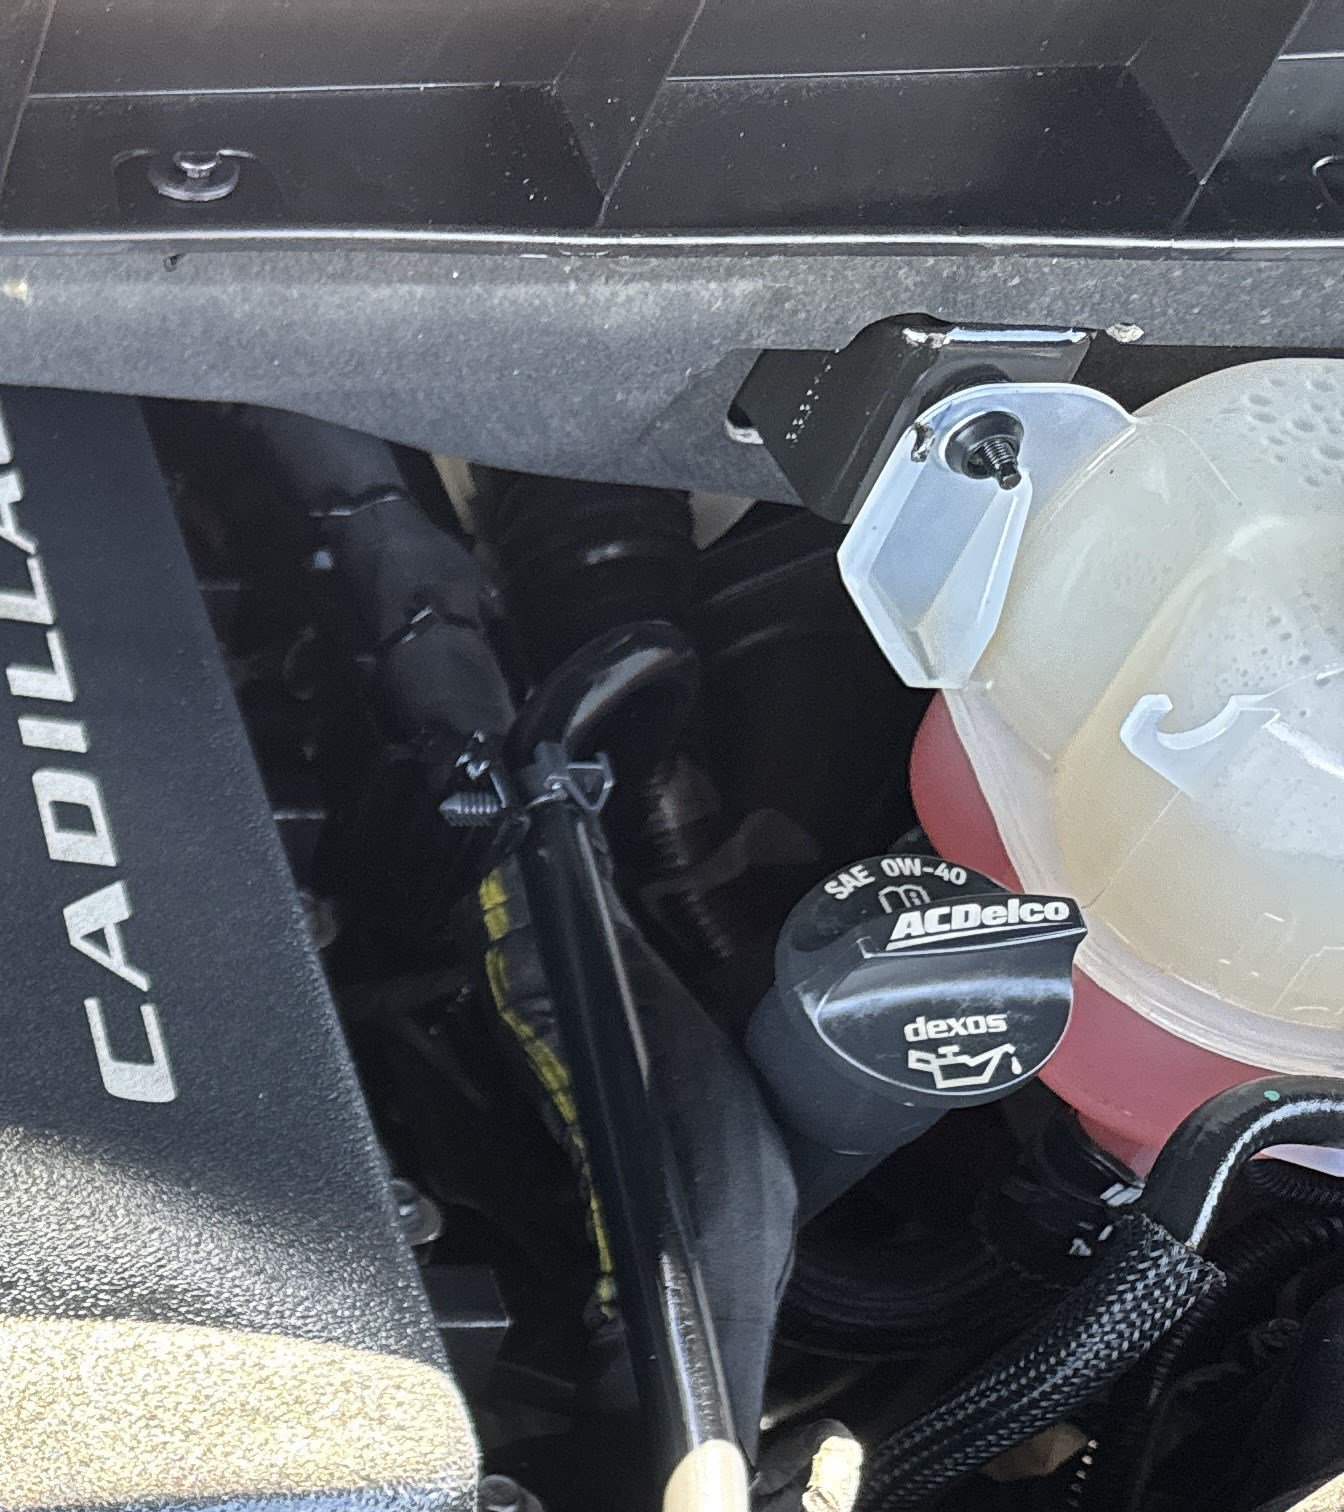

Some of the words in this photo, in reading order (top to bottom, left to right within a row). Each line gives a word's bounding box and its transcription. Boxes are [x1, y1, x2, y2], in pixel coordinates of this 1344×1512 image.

[823, 864, 876, 900] SAE
[880, 857, 968, 886] 0W-40
[889, 898, 1070, 941] ACDelco
[903, 1012, 1009, 1043] dexos
